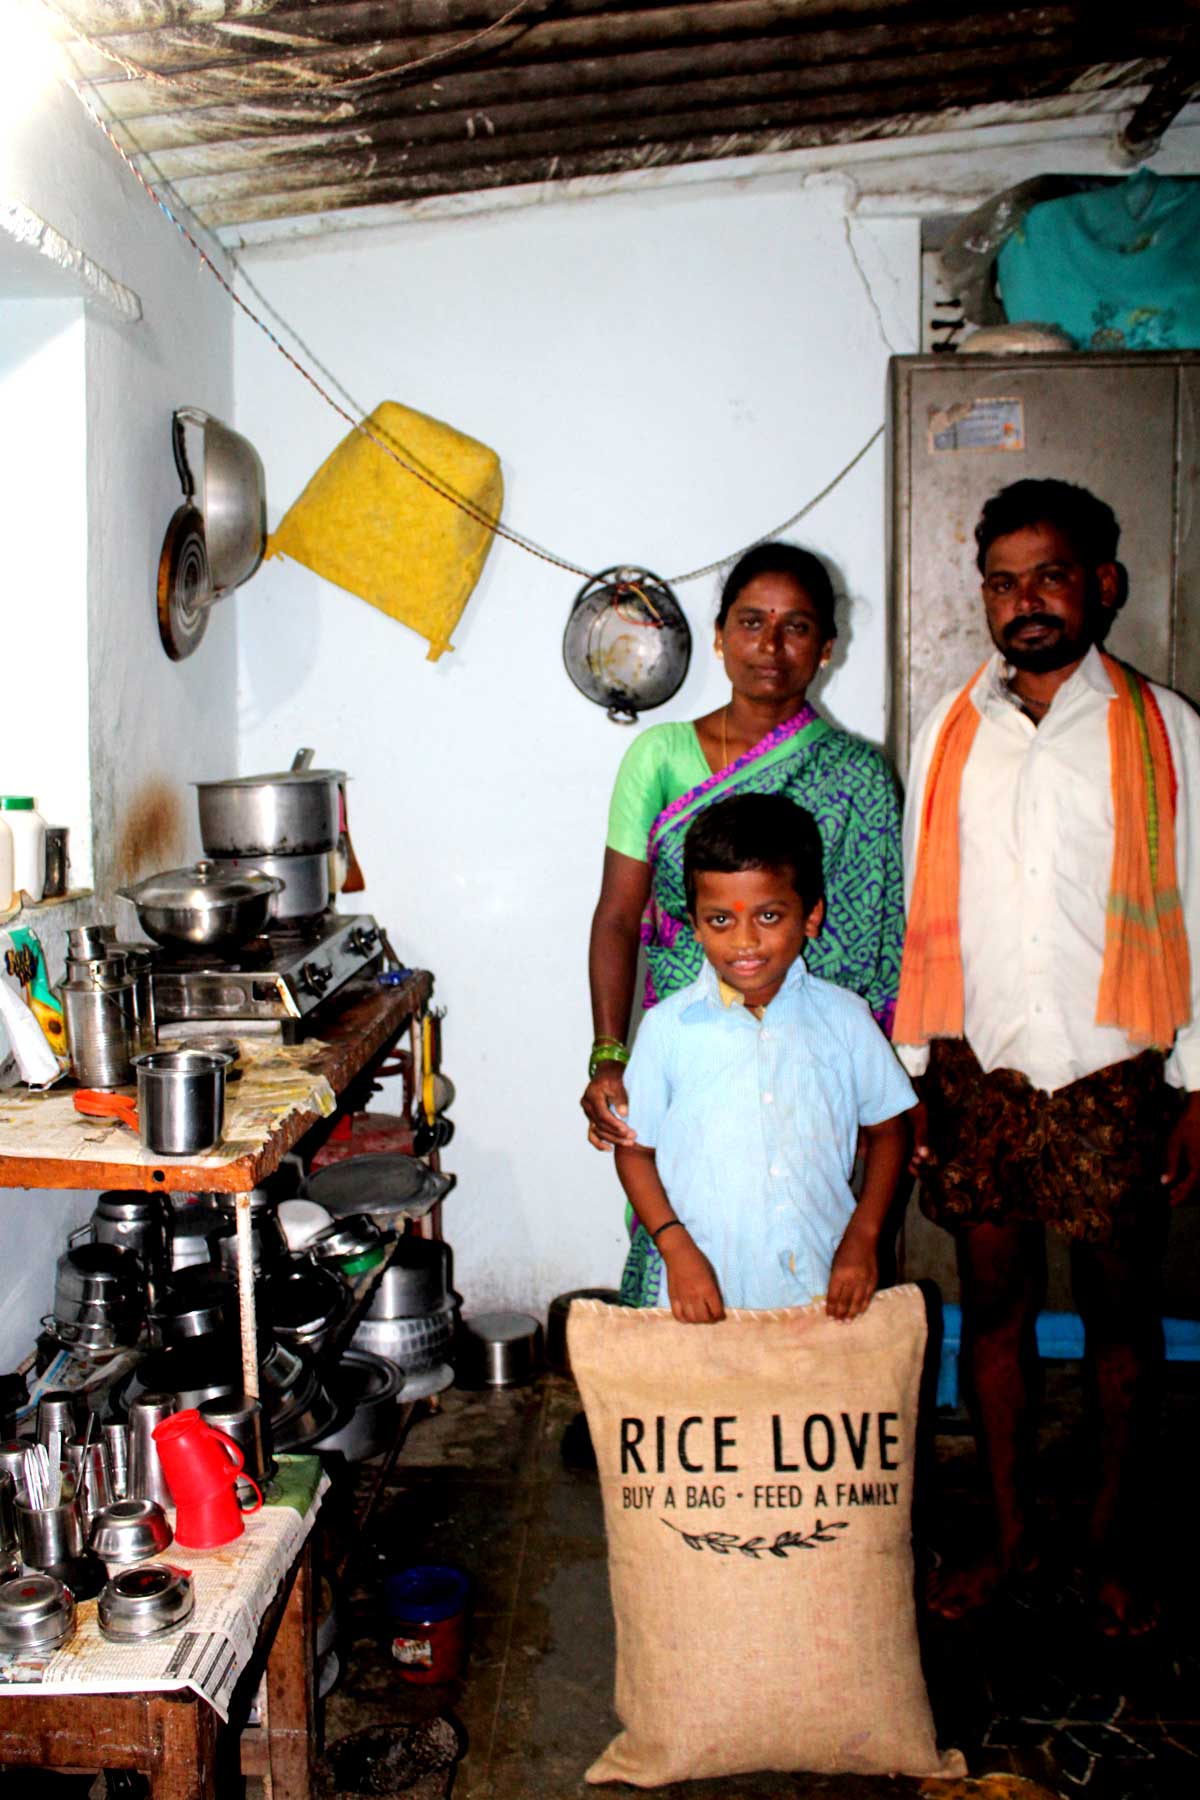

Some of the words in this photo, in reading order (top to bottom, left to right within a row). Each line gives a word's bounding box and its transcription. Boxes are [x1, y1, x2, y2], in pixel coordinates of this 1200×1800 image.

[620, 1416, 738, 1475] RICE
[771, 1412, 899, 1473] LOVE
[623, 1486, 655, 1509] BUY
[664, 1486, 676, 1509] A
[686, 1486, 726, 1509] BAG
[753, 1485, 803, 1508] FEED
[814, 1485, 829, 1508] A
[835, 1483, 899, 1508] FAMILY
